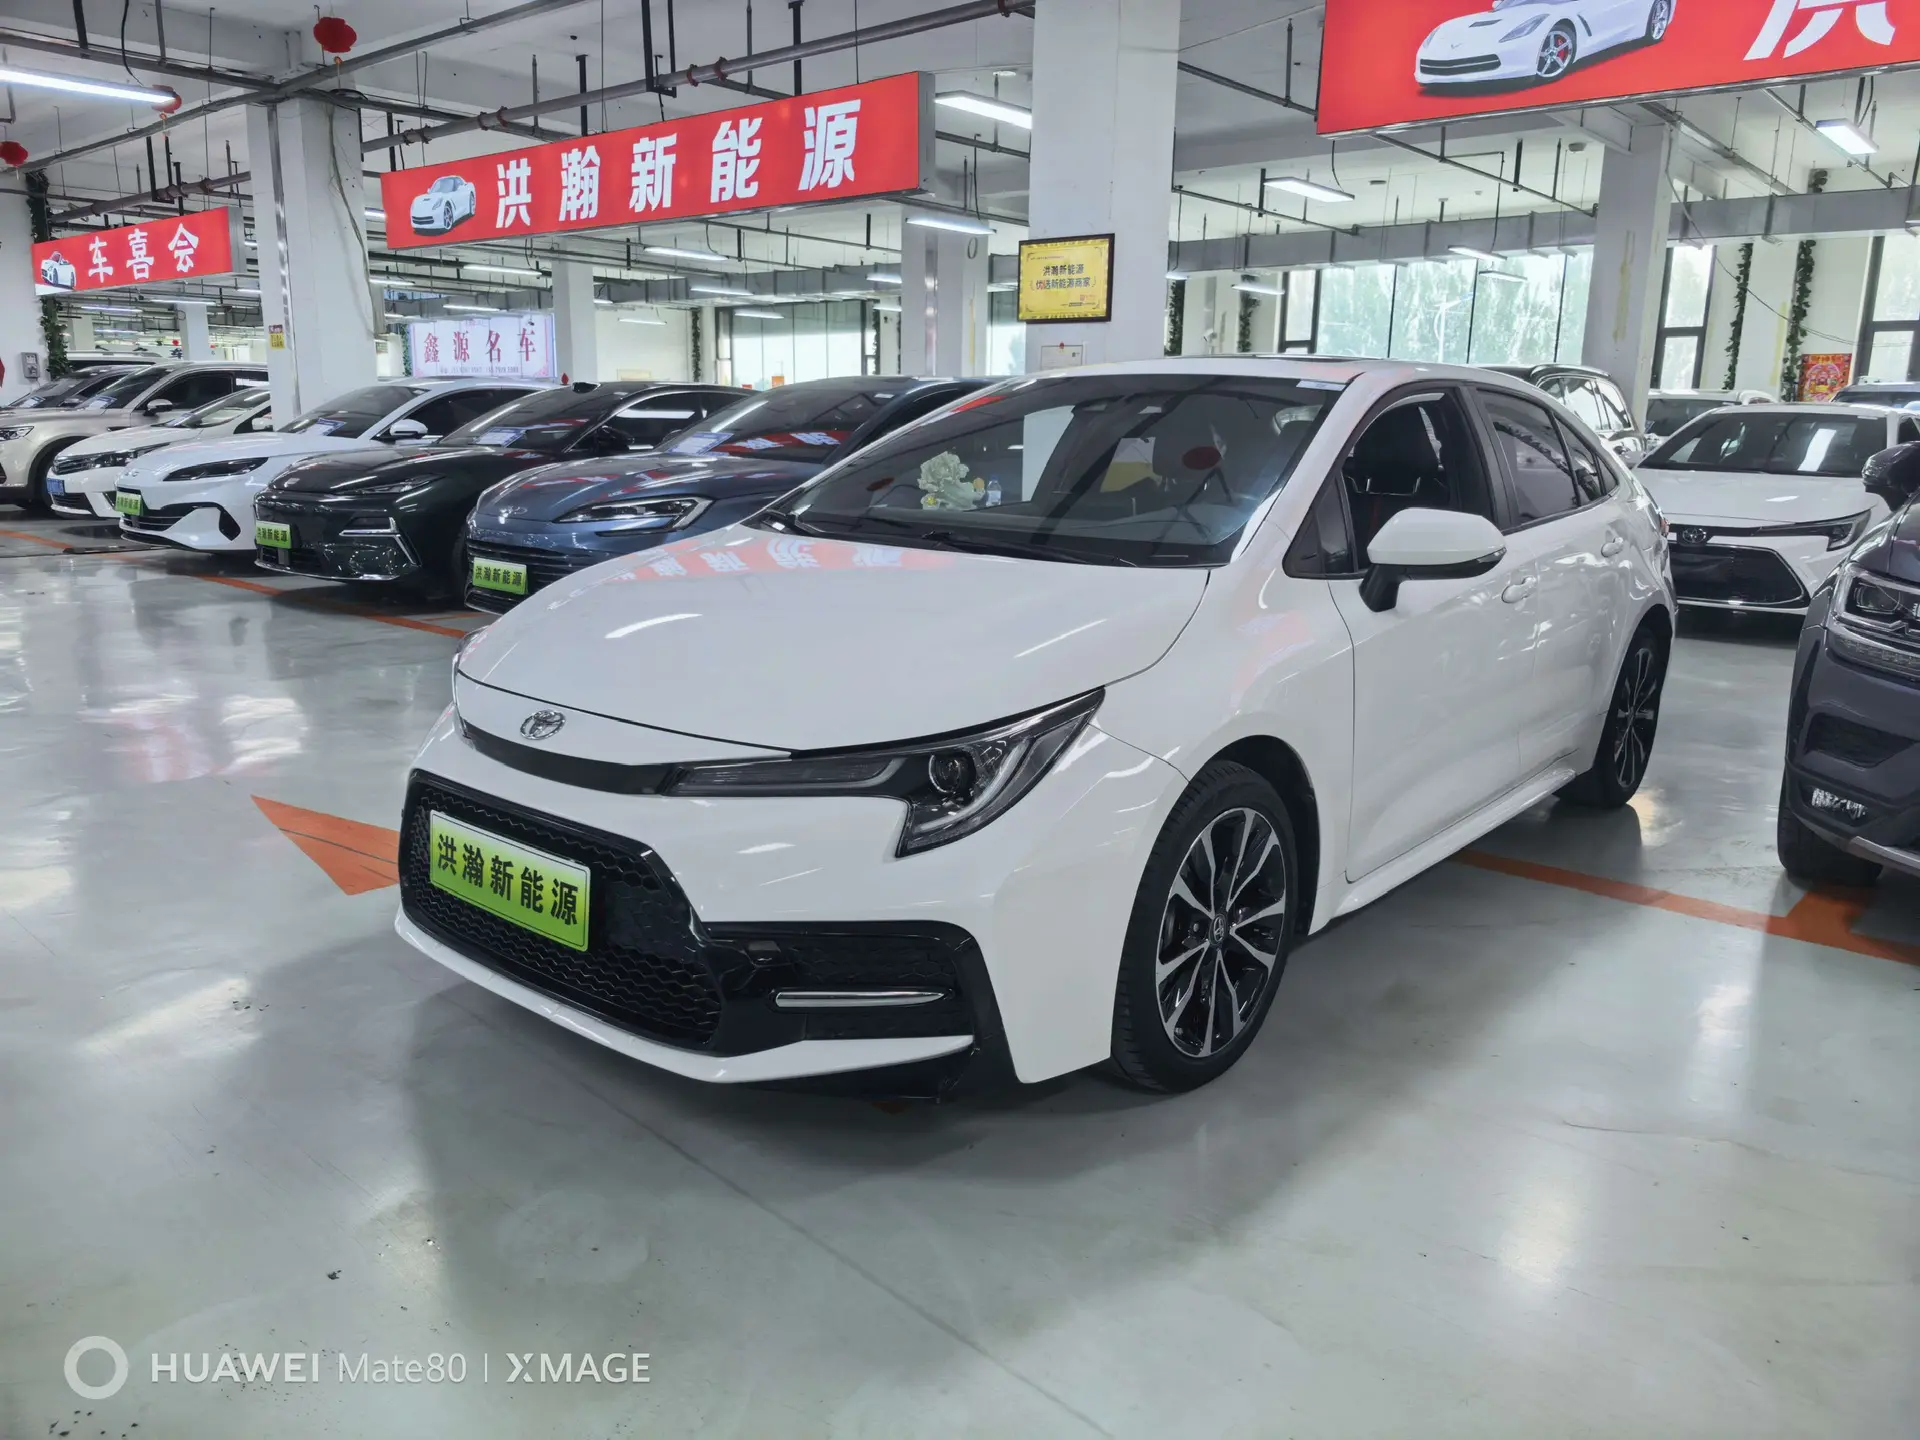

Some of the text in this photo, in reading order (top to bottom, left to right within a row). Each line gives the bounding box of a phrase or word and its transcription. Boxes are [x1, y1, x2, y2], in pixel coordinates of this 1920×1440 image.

[495, 99, 861, 228] 洪瀚新能源
[88, 222, 200, 283] 车喜会
[424, 327, 537, 363] 鑫源名车
[475, 565, 523, 587] 洪瀚新能源
[437, 833, 579, 926] 洪瀚新能源
